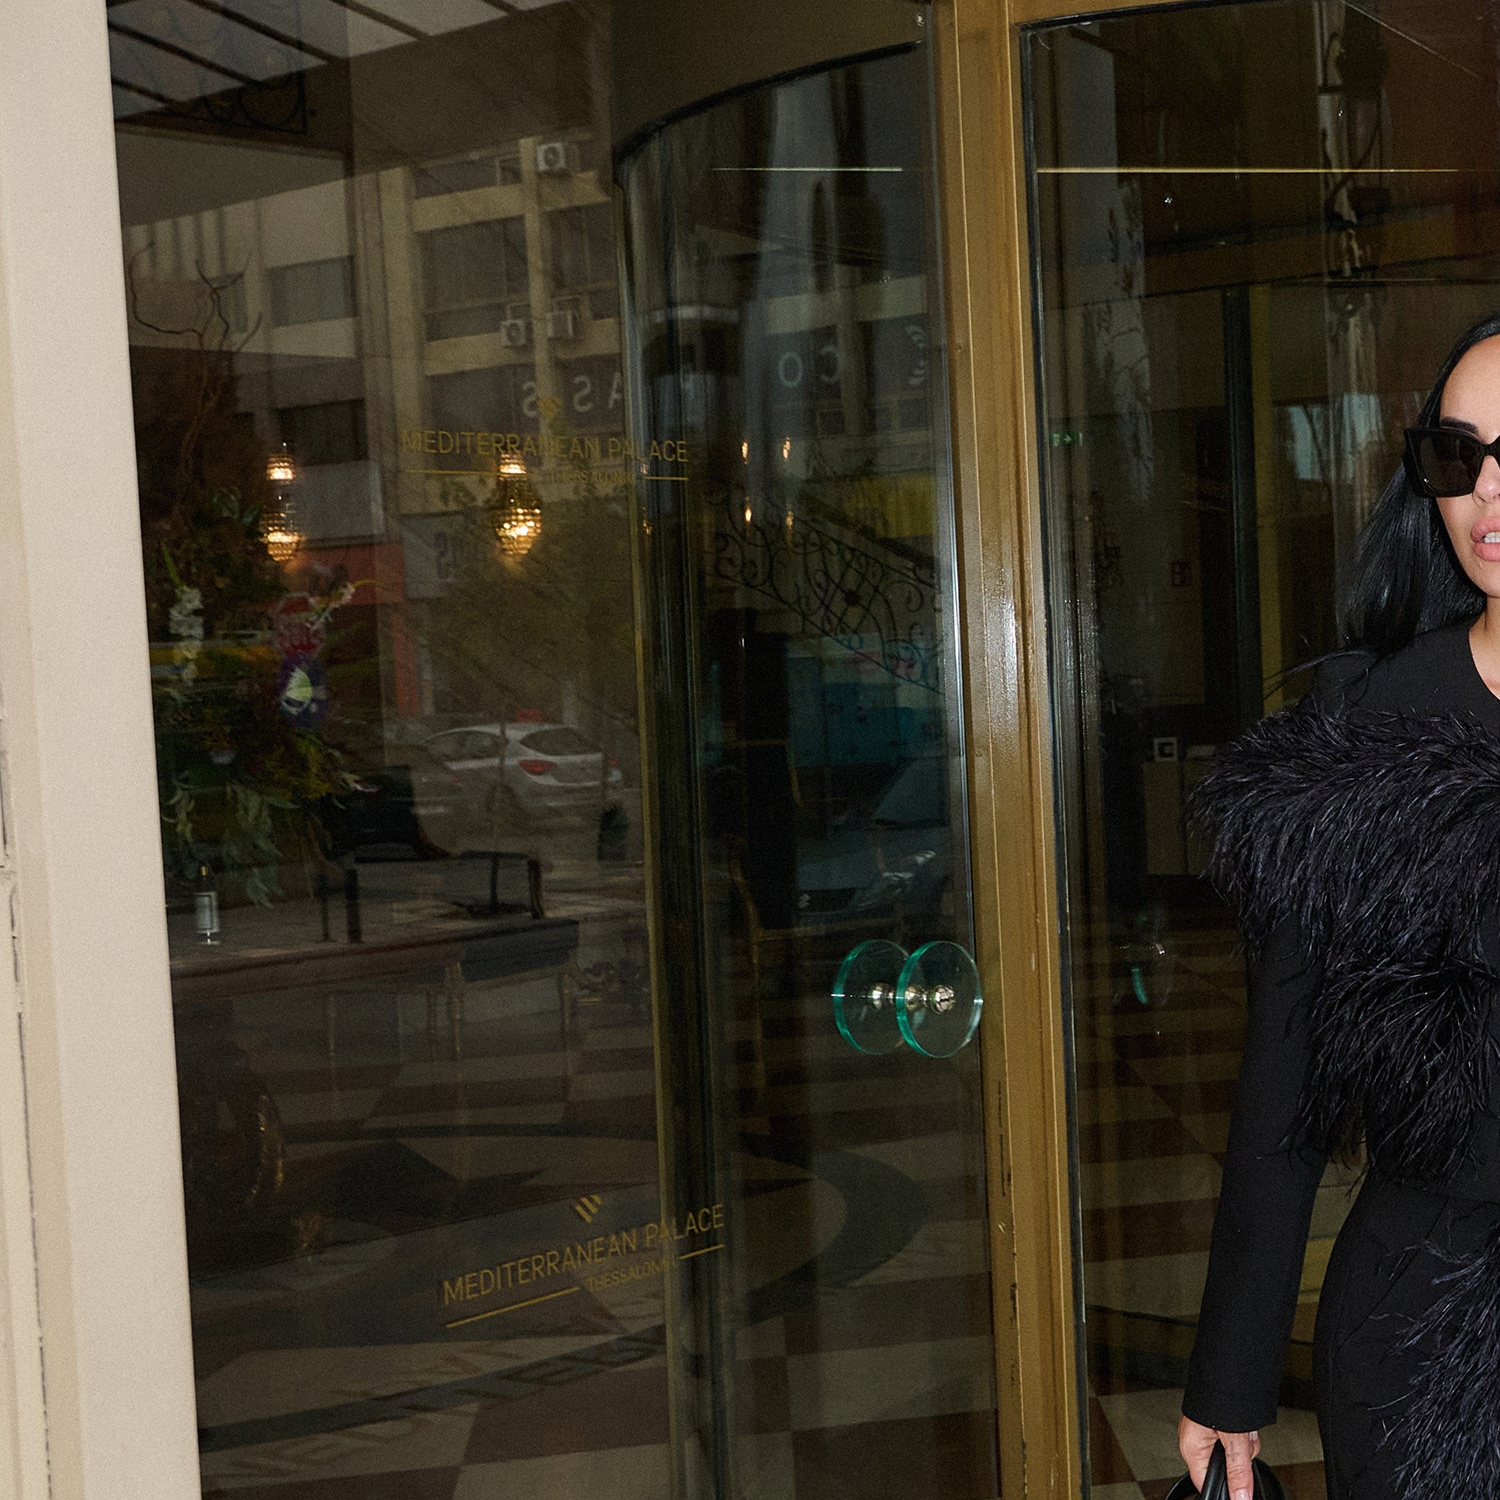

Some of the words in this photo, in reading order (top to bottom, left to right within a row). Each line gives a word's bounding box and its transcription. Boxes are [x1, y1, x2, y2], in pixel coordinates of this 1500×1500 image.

[401, 429, 599, 460] MEDITERRANEAN
[609, 438, 689, 462] PALACE
[443, 1227, 637, 1306] MEDITERRANEAN
[645, 1204, 725, 1248] PALACE
